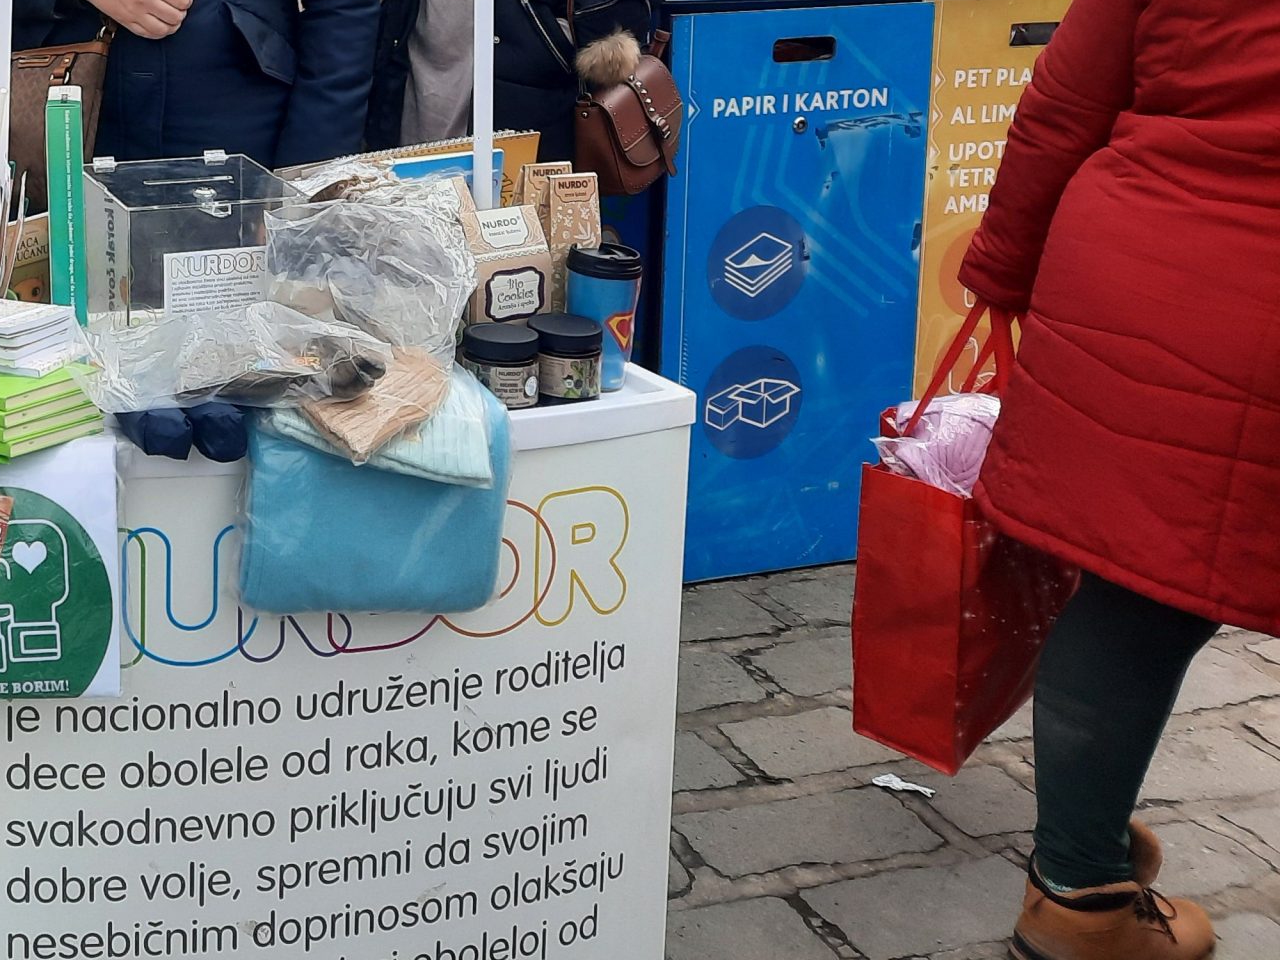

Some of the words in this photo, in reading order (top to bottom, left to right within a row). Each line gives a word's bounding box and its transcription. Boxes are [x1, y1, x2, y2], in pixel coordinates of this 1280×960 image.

[954, 68, 991, 88] PET
[996, 67, 1033, 86] PLA
[712, 95, 776, 118] PAPIR
[782, 94, 789, 113] I
[795, 87, 888, 112] KARTON
[950, 106, 976, 125] AL
[980, 104, 1017, 124] LIM
[948, 140, 1006, 161] UPOT
[558, 180, 589, 190] NURDO
[946, 166, 996, 188] TETR
[943, 194, 989, 215] AMB
[482, 218, 518, 230] NURDO
[171, 251, 266, 279] NURDOR
[497, 289, 534, 304] Cookies
[119, 486, 629, 668] UOR
[7, 704, 40, 742] je
[55, 689, 281, 732] nacionalno
[295, 667, 483, 721] udruženje
[495, 640, 625, 695] roditelja
[12, 680, 70, 694] BORIM!
[6, 752, 106, 790] dece
[120, 746, 268, 788] obolele
[281, 738, 331, 778] od
[345, 730, 438, 771] raka,
[453, 715, 550, 756] kome
[561, 705, 597, 736] se
[6, 807, 275, 847] svakodnevno
[290, 779, 476, 843] priključuju
[488, 765, 532, 805] svi
[544, 746, 608, 801] ljudi
[6, 866, 128, 904] dobre
[140, 861, 241, 907] volje,
[256, 840, 412, 899] spremni
[424, 832, 470, 869] da
[482, 812, 588, 859] svojim
[7, 920, 238, 959] nesebičnim
[252, 890, 478, 952] doprinosom
[490, 852, 624, 911] olakšaju
[414, 920, 547, 960] boleloj
[558, 903, 598, 946] od
